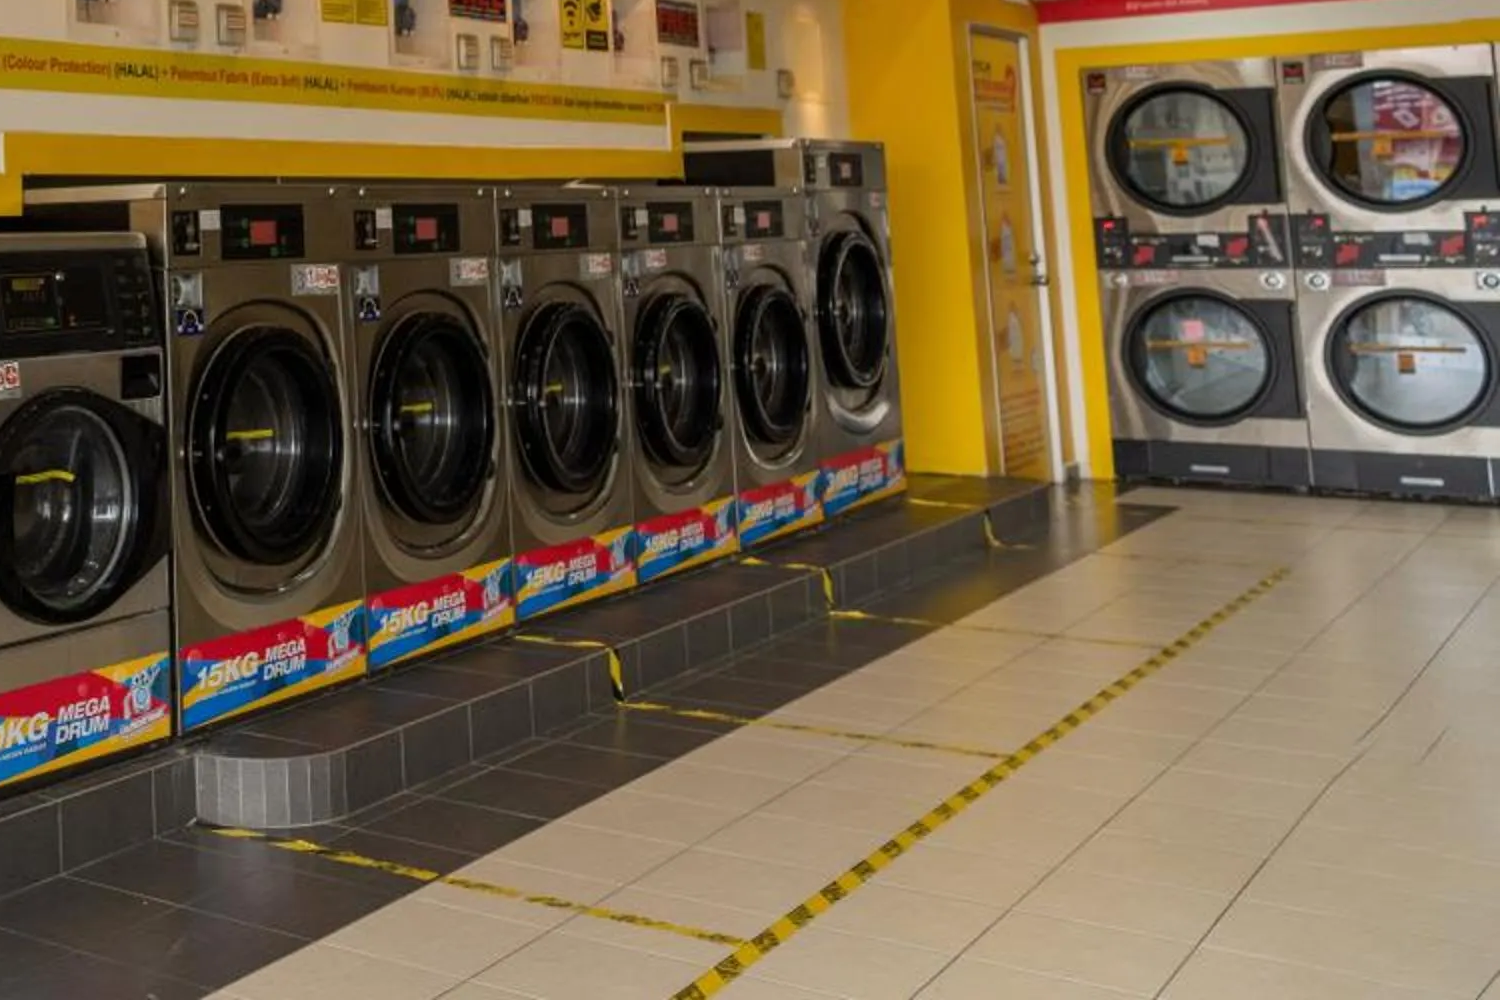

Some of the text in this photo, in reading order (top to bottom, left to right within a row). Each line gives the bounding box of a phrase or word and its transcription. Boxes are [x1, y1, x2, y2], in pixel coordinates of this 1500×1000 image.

[114, 62, 159, 86] (HALAL)
[380, 590, 466, 635] 15KG MEGA
[431, 605, 467, 629] DRUM
[197, 638, 306, 691] 15KG MEGA
[263, 655, 306, 681] DRUM
[58, 696, 111, 726] MEGA
[55, 714, 110, 746] DRUM
